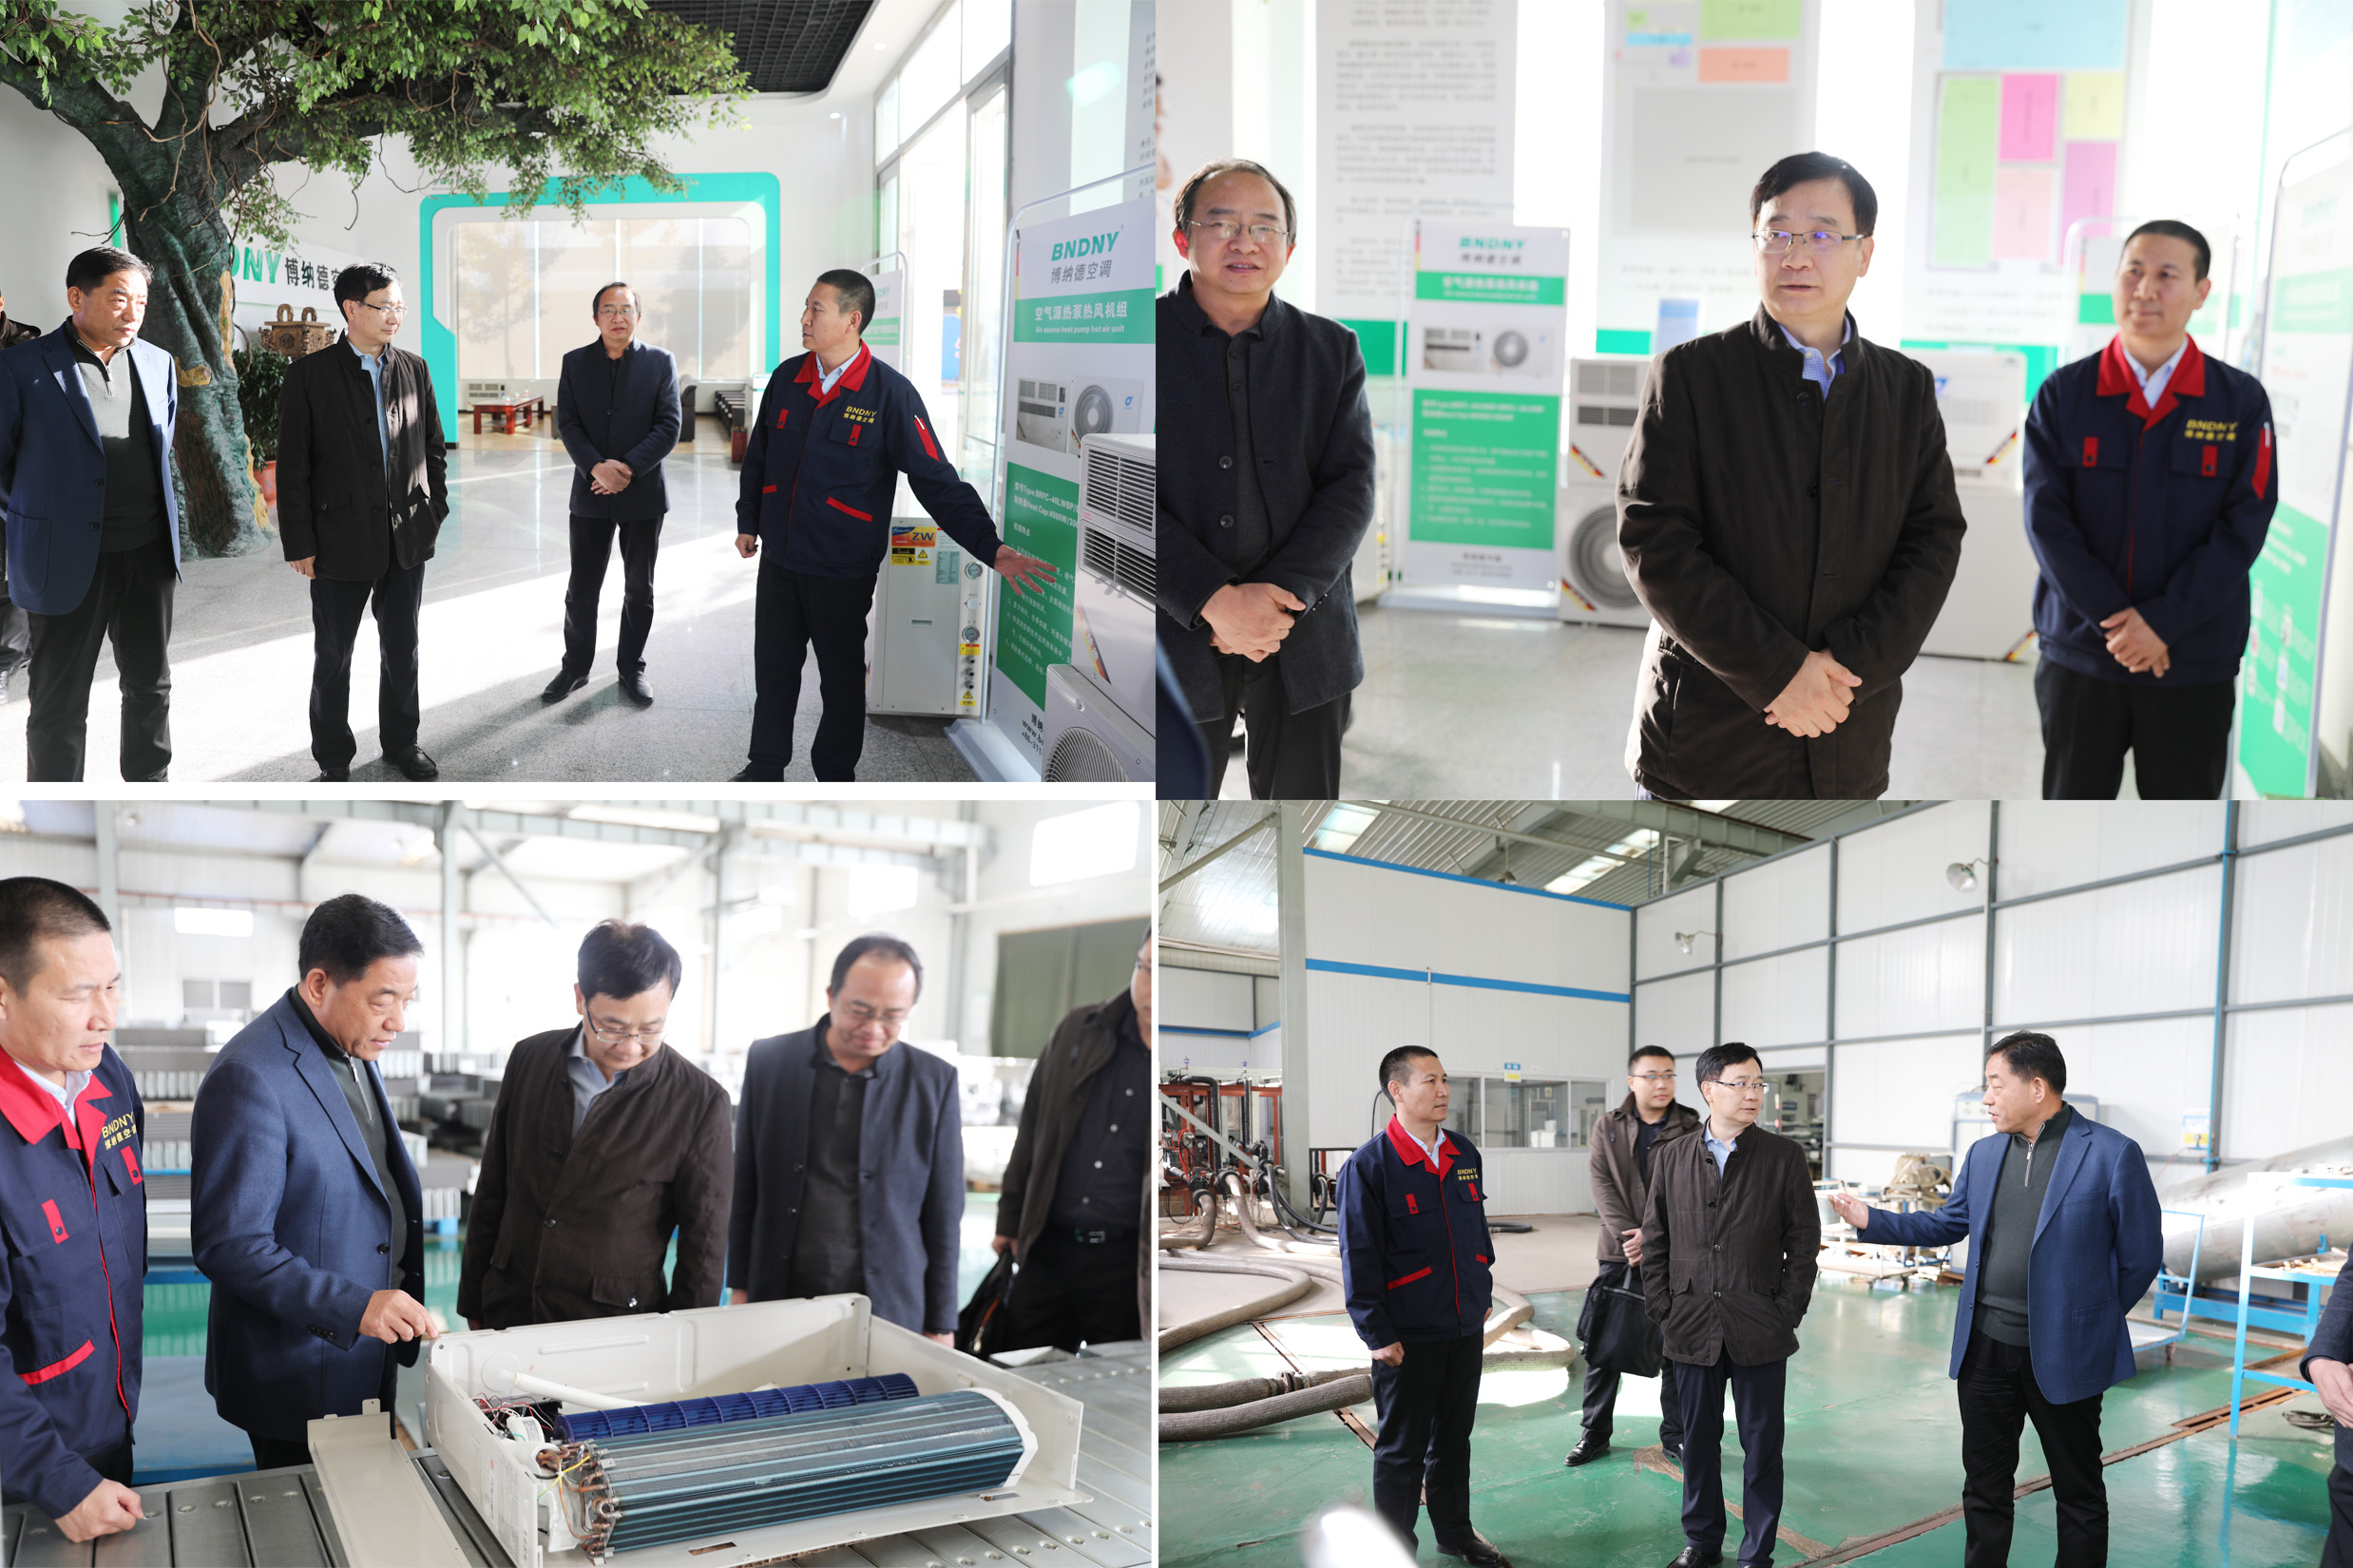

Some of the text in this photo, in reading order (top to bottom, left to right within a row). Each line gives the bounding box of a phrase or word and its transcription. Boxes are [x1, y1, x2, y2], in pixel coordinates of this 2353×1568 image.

[1051, 231, 1119, 261] BNDNY
[1050, 259, 1113, 285] 博纳德空调
[1034, 300, 1128, 321] 空气源热泵热风机组
[1073, 325, 1090, 335] pump
[1090, 324, 1101, 333] hot
[1101, 324, 1111, 333] air
[1111, 323, 1125, 333] unit
[846, 405, 877, 418] BNDNY
[912, 532, 934, 541] ZW
[102, 1111, 134, 1138] BNDNY
